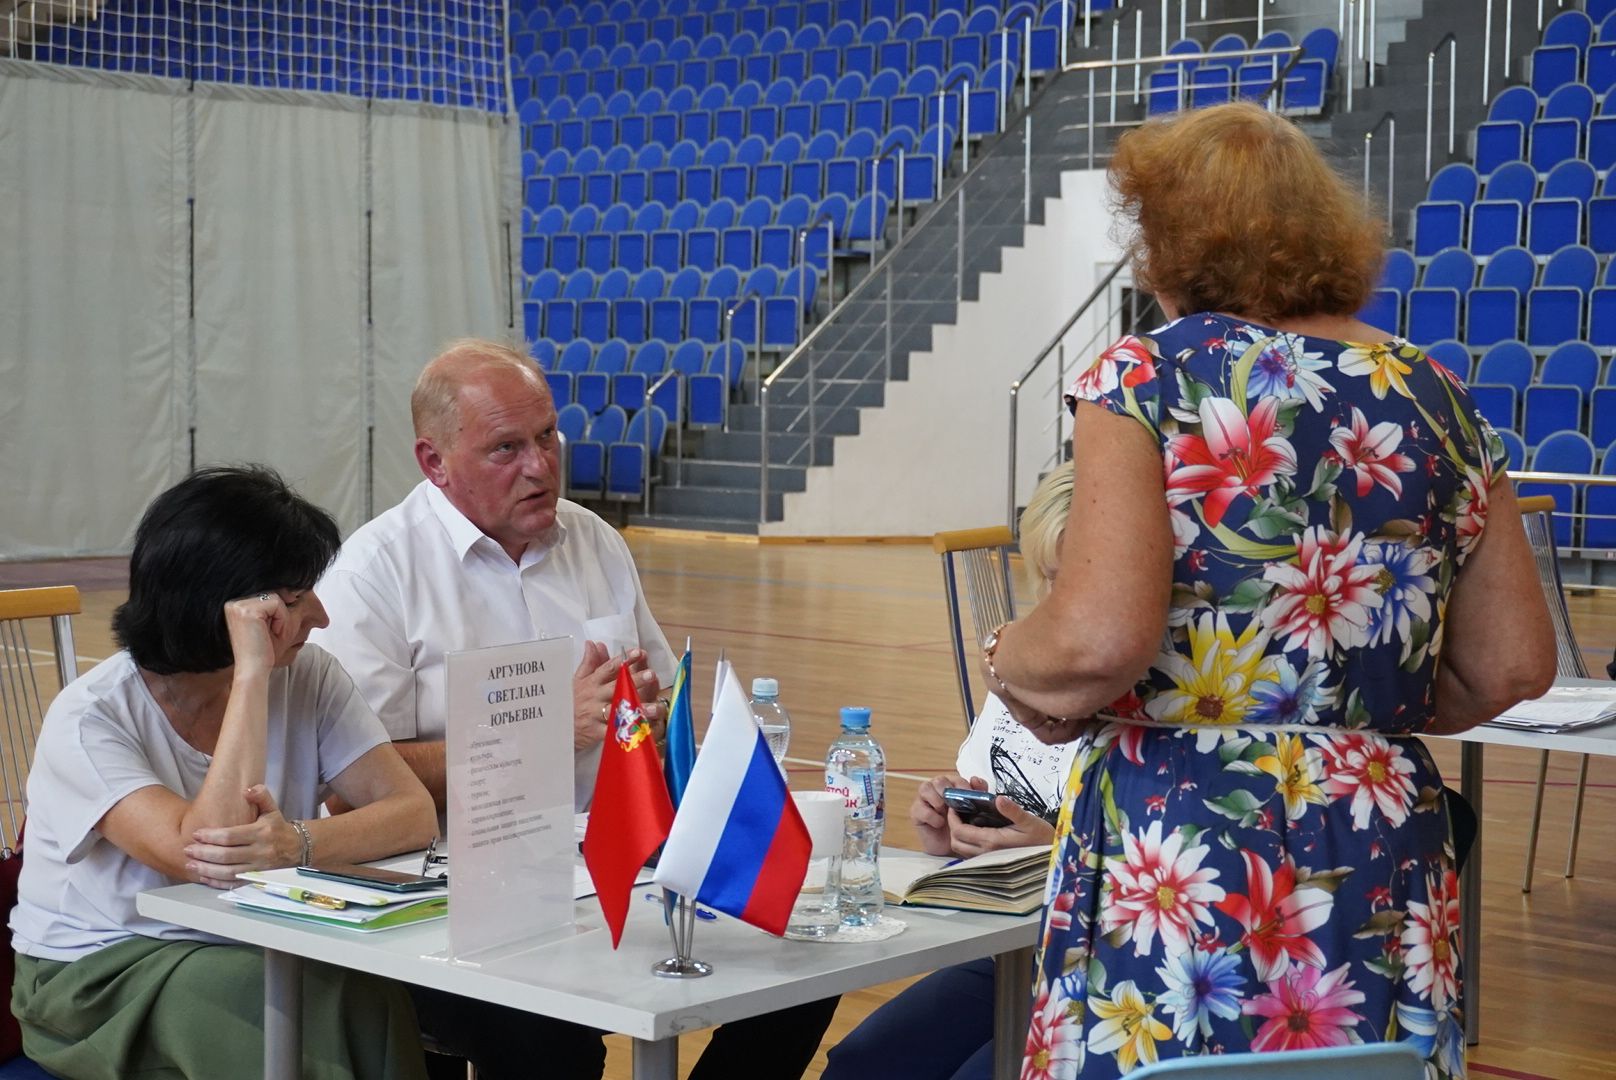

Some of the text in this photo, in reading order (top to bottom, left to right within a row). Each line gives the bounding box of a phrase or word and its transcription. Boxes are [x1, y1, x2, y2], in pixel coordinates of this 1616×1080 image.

[488, 660, 545, 680] АРГУНОВА
[488, 684, 545, 704] СВЕТЛАНА
[490, 706, 543, 727] ЮРЬЕВНА
